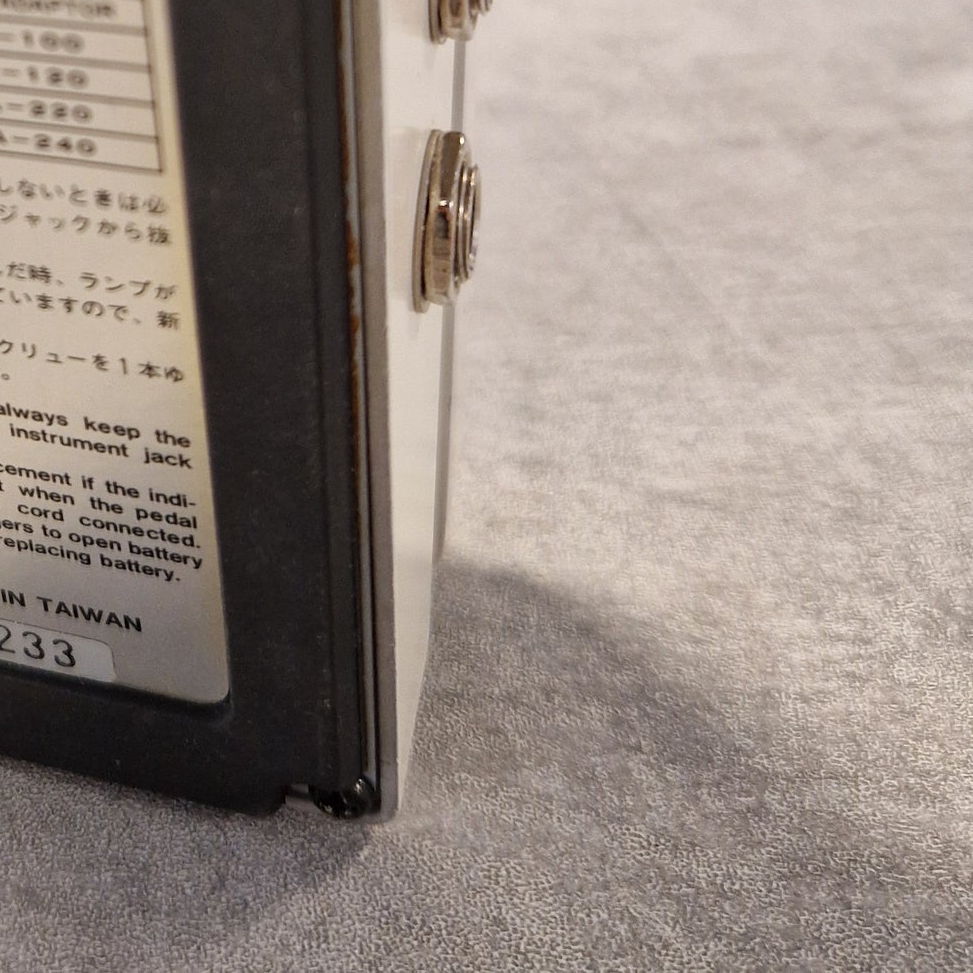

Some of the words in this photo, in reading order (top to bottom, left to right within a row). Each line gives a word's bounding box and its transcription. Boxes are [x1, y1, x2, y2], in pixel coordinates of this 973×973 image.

[9, 423, 129, 458] instrument
[143, 447, 193, 469] jack
[83, 416, 141, 440] keep
[154, 429, 191, 448] the
[18, 484, 75, 506] when
[89, 496, 124, 515] the
[135, 507, 198, 530] pedal
[81, 475, 95, 490] if
[105, 480, 140, 499] the
[148, 488, 197, 508] indi-
[17, 502, 65, 522] cord
[78, 515, 202, 550] connected.
[41, 524, 61, 540] to
[68, 531, 122, 552] open
[128, 539, 203, 571] battery
[100, 553, 182, 583] battery.
[0, 588, 26, 607] IN
[36, 596, 143, 633] TAIWAN
